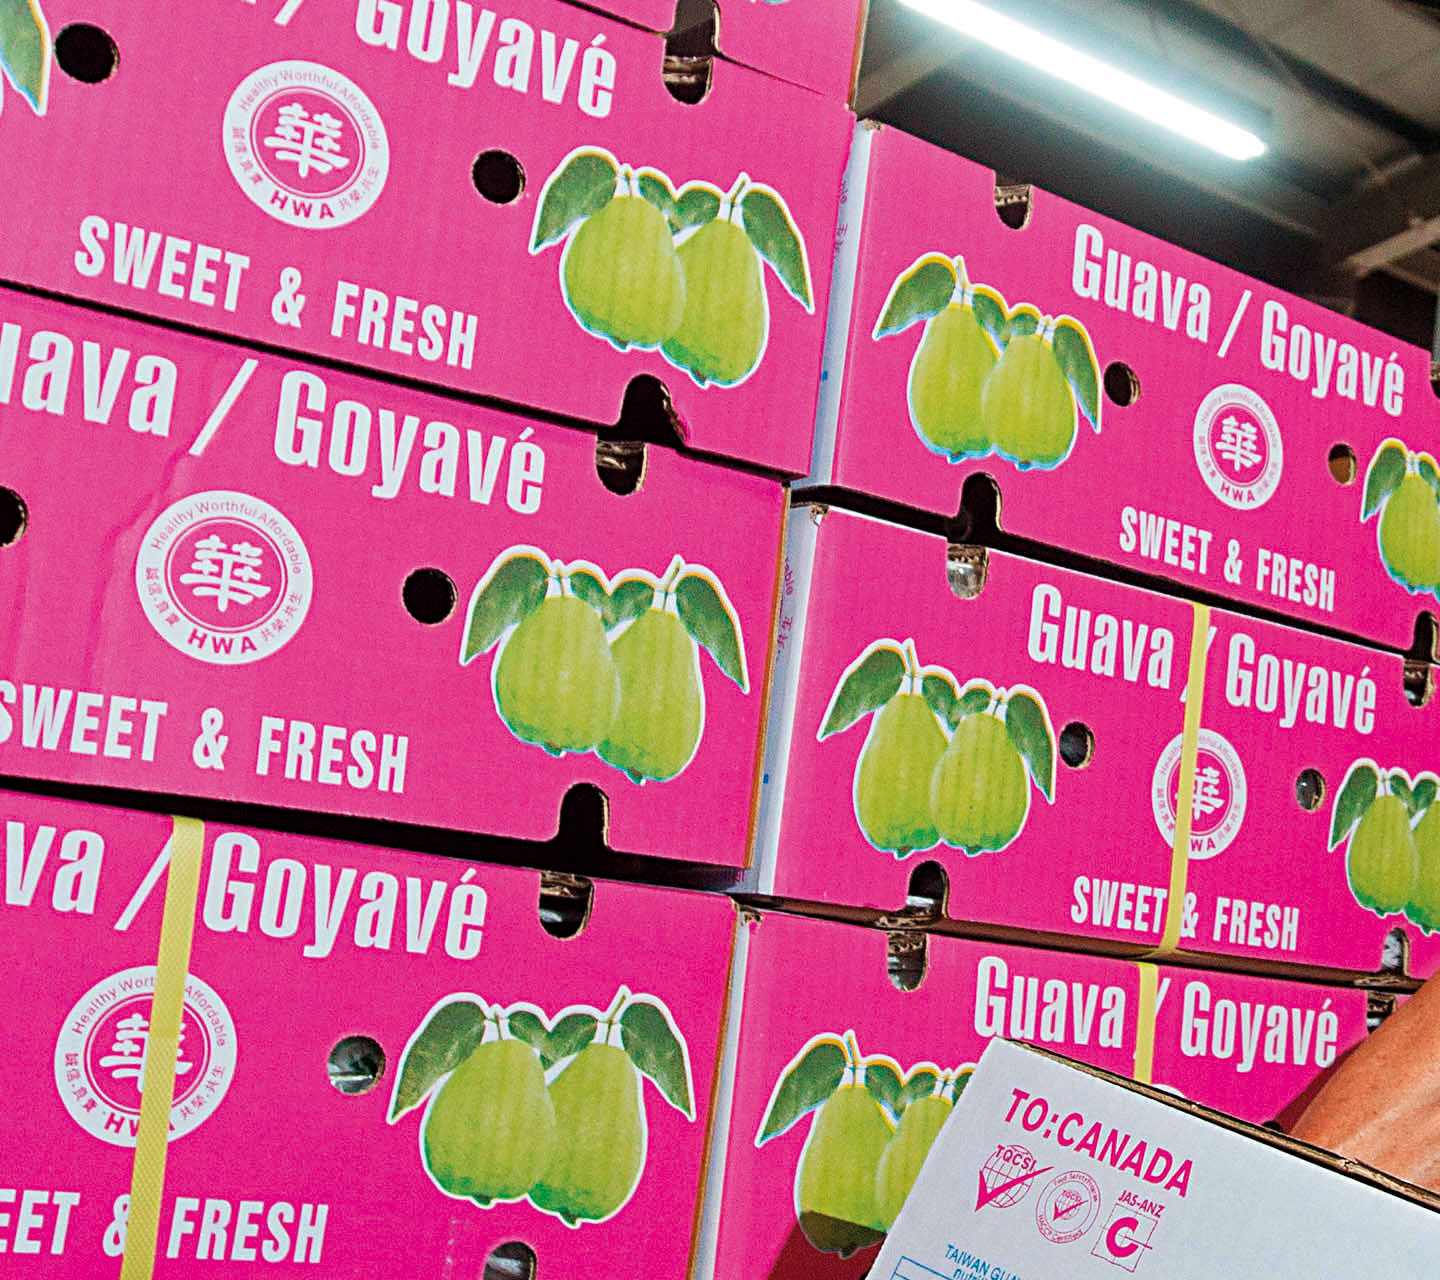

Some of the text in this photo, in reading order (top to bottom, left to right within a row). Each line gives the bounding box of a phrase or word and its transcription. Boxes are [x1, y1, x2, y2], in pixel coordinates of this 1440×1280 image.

[270, 189, 334, 219] HWA
[75, 216, 478, 370] SWEET & FRESH
[1072, 224, 1210, 343] Guava
[1261, 301, 1404, 416] Goyavé
[274, 371, 545, 514] Goyavé
[1220, 480, 1255, 504] HWA
[151, 500, 303, 575] Healthy Worthful Affordable
[1120, 506, 1334, 611] SWEET & FRESH
[188, 629, 257, 654] HWA
[1028, 584, 1376, 734] Guava Goyavé
[193, 708, 228, 770] &
[256, 716, 408, 793] FRESH
[203, 832, 487, 959] Goyavé
[1071, 876, 1167, 933] SWEET
[1213, 897, 1299, 950] FRESH
[73, 990, 119, 1034] Healthy
[975, 955, 1338, 1072] Guava Goyavé
[1005, 1087, 1192, 1197] TO:CANADA
[167, 1197, 328, 1263] FRESH
[1117, 1189, 1166, 1219] JAS-ANZ
[944, 1243, 991, 1277] TAIWAN
